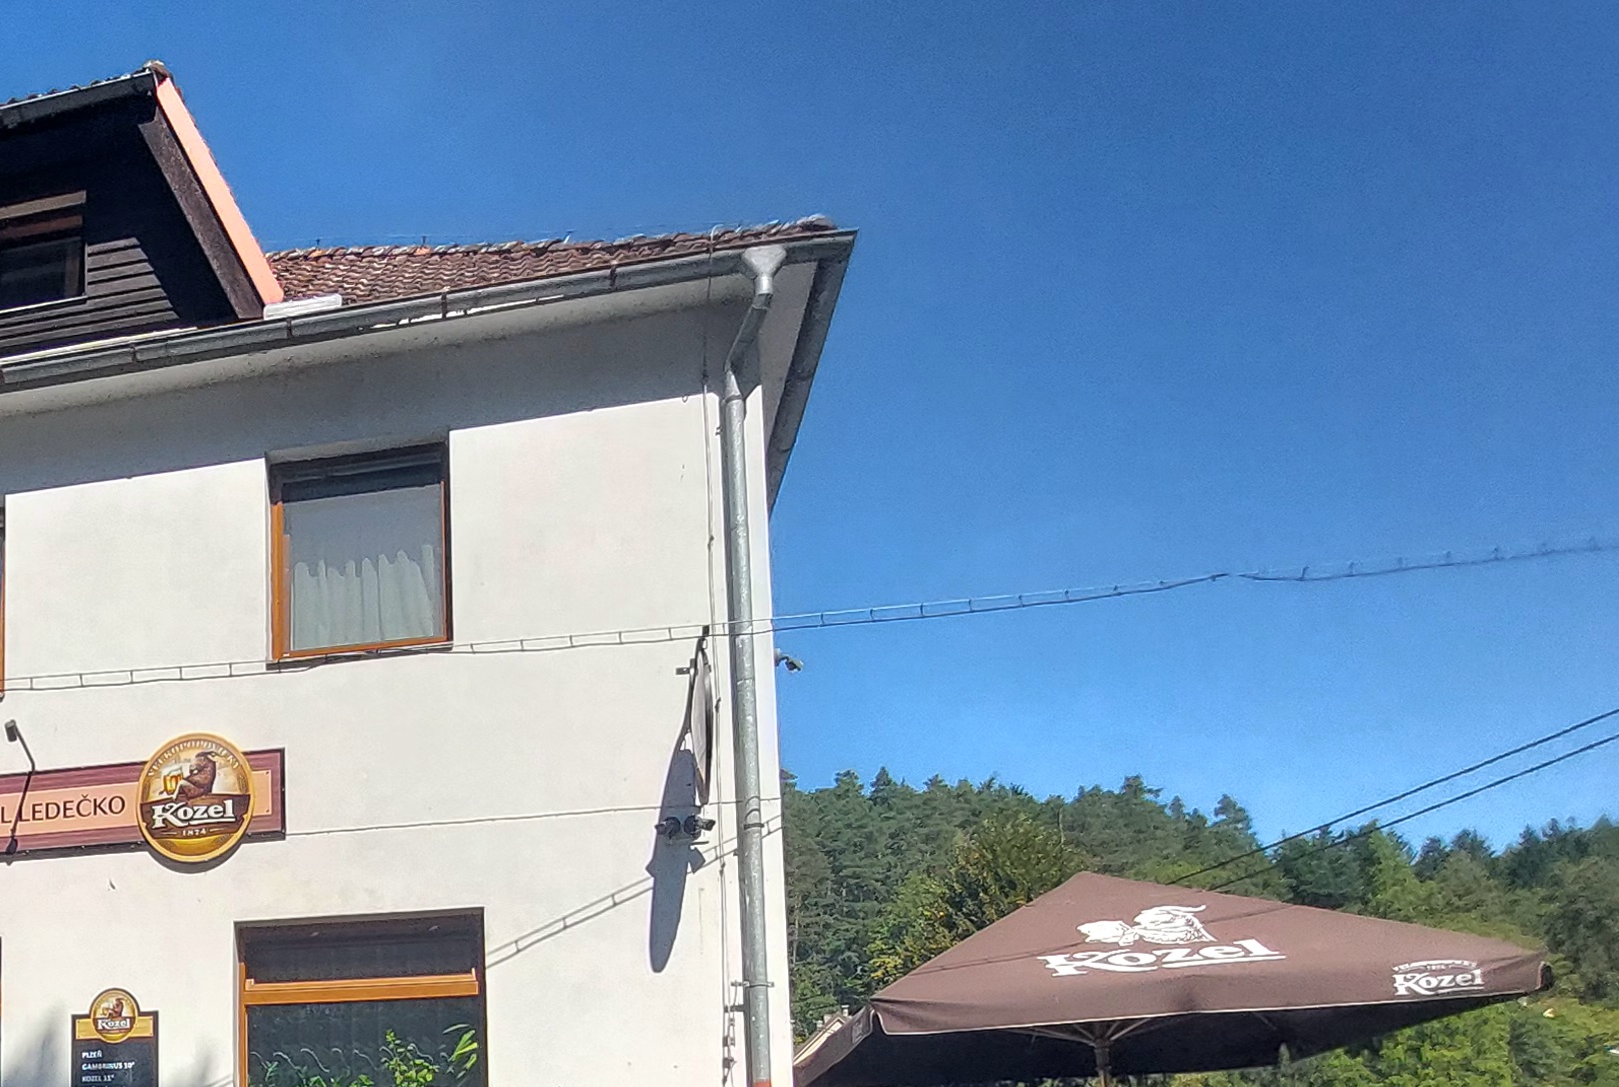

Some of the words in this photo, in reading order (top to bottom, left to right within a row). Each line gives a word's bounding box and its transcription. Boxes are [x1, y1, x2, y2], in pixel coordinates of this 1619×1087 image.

[18, 794, 126, 822] LEDEČKO
[151, 799, 236, 829] Kozel
[1037, 939, 1287, 977] Kozel
[1392, 968, 1485, 996] Kozel
[96, 1018, 131, 1030] Kozel
